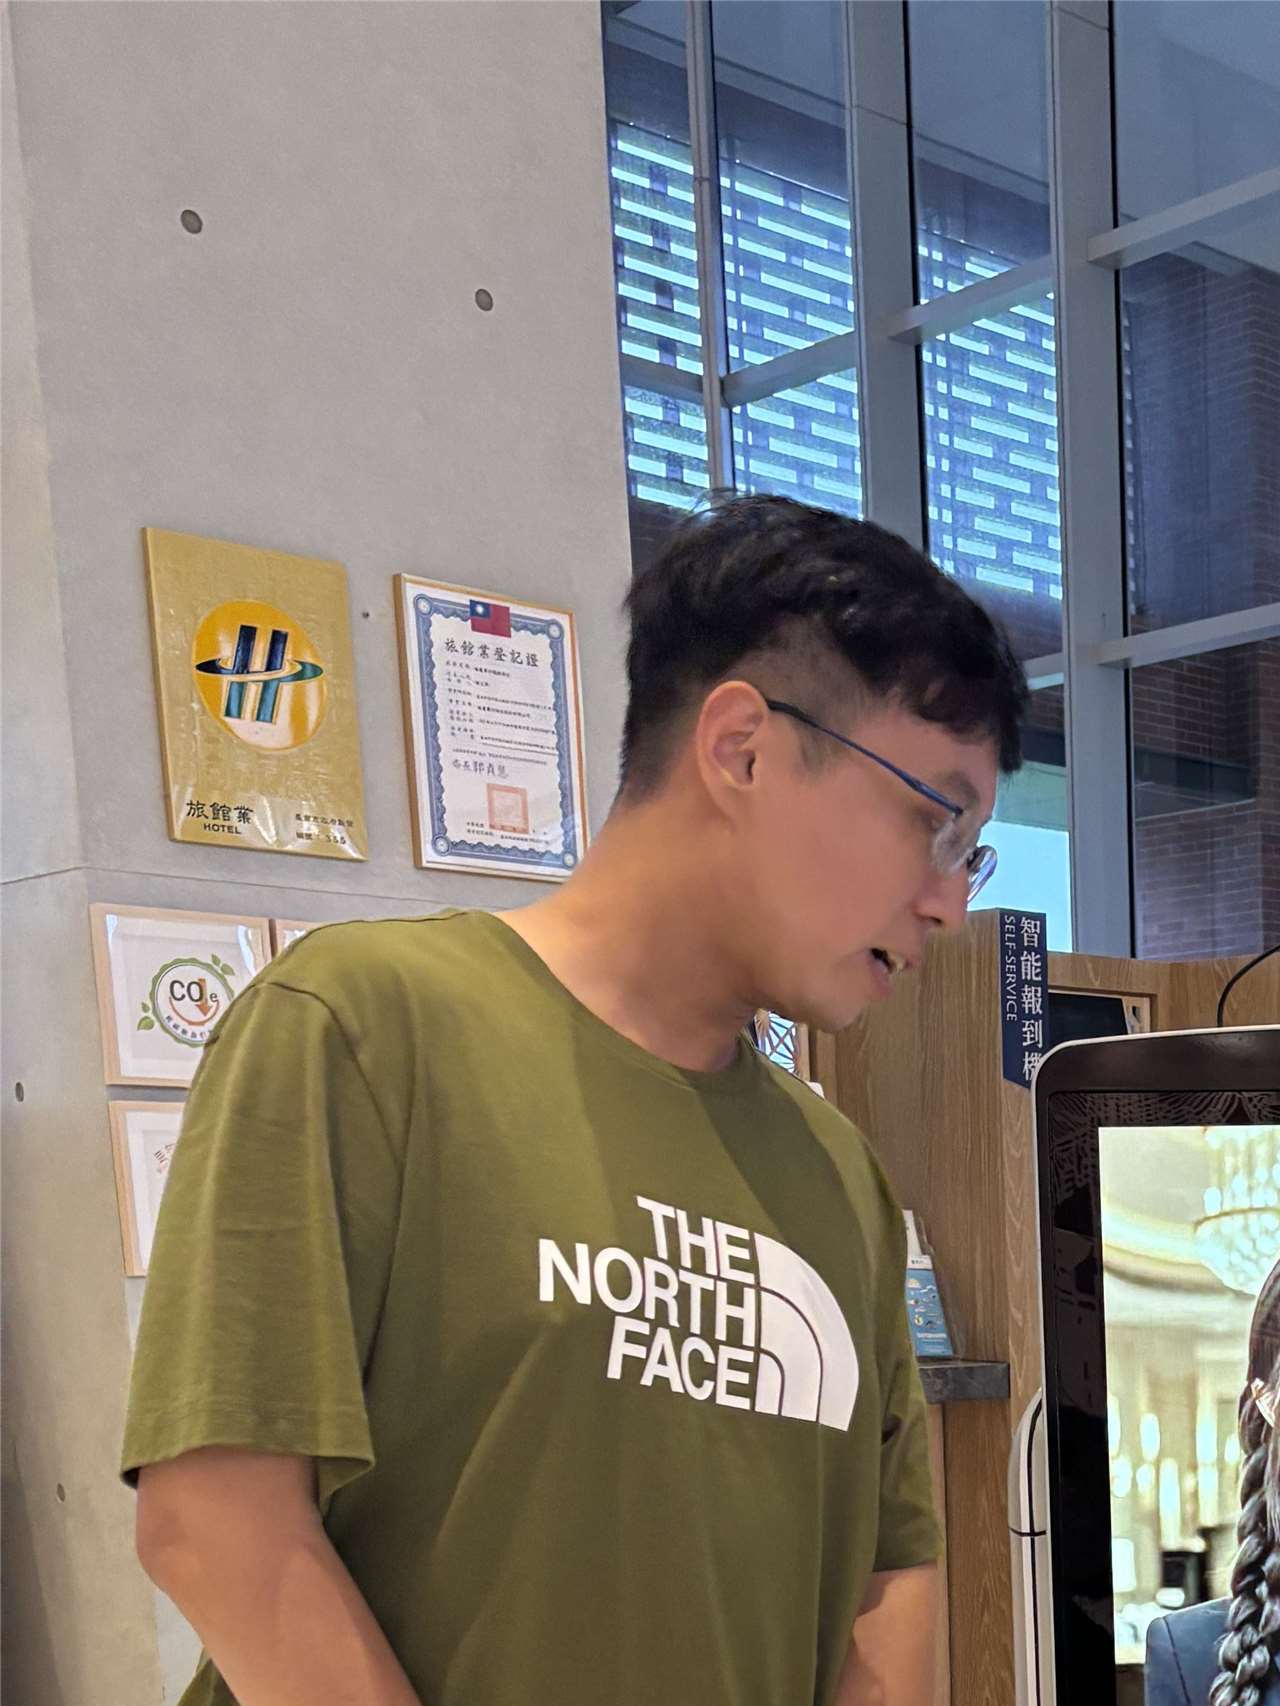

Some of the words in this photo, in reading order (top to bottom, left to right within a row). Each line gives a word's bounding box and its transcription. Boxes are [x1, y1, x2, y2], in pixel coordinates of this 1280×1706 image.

[445, 638, 539, 667] 旅館業登記證
[186, 799, 254, 825] 旅館業
[203, 823, 242, 835] HOTEL
[1004, 914, 1018, 1022] SELF-SERVICE
[637, 1195, 755, 1285] THE
[539, 1238, 756, 1347] NORTH
[607, 1315, 754, 1410] FACE
